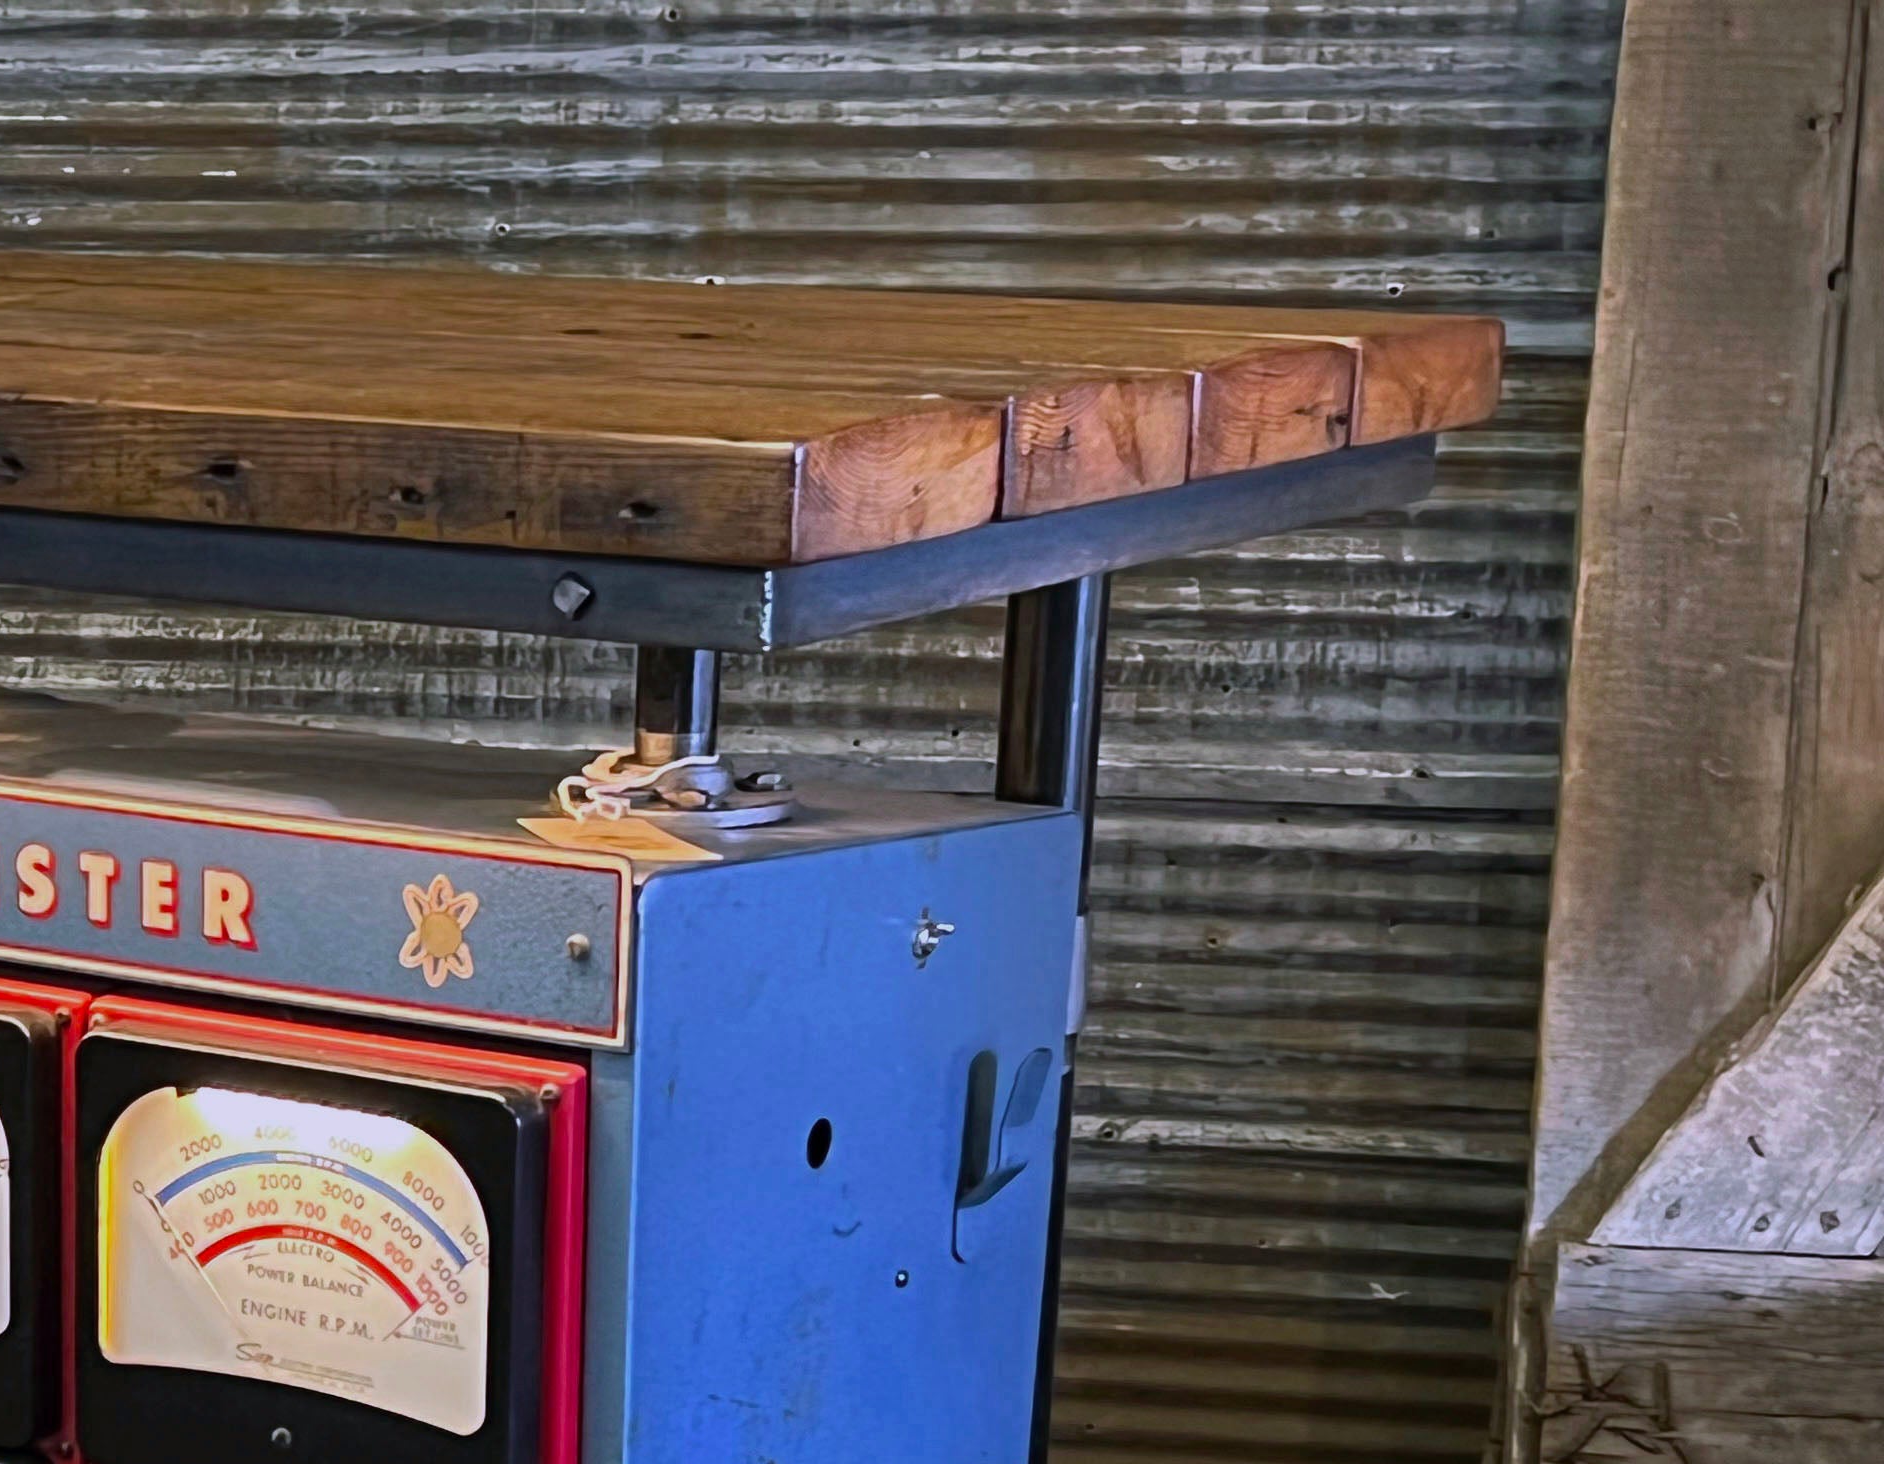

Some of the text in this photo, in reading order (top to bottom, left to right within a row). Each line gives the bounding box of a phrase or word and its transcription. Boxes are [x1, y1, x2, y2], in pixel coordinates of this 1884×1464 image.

[179, 1133, 223, 1162] 2000
[402, 1169, 445, 1212] 8000
[198, 1179, 237, 1206] 1000
[257, 1173, 303, 1191] 2000
[321, 1178, 366, 1211] 3000
[380, 1210, 423, 1250] 4000
[430, 1257, 469, 1305] 5000
[203, 1207, 236, 1233] 500
[246, 1198, 279, 1218] 600
[294, 1199, 327, 1221] 700
[339, 1213, 373, 1242] 800
[276, 1241, 336, 1264] ELECTRO
[247, 1263, 364, 1298] POWER BALANCE
[240, 1298, 308, 1328] ENGINE
